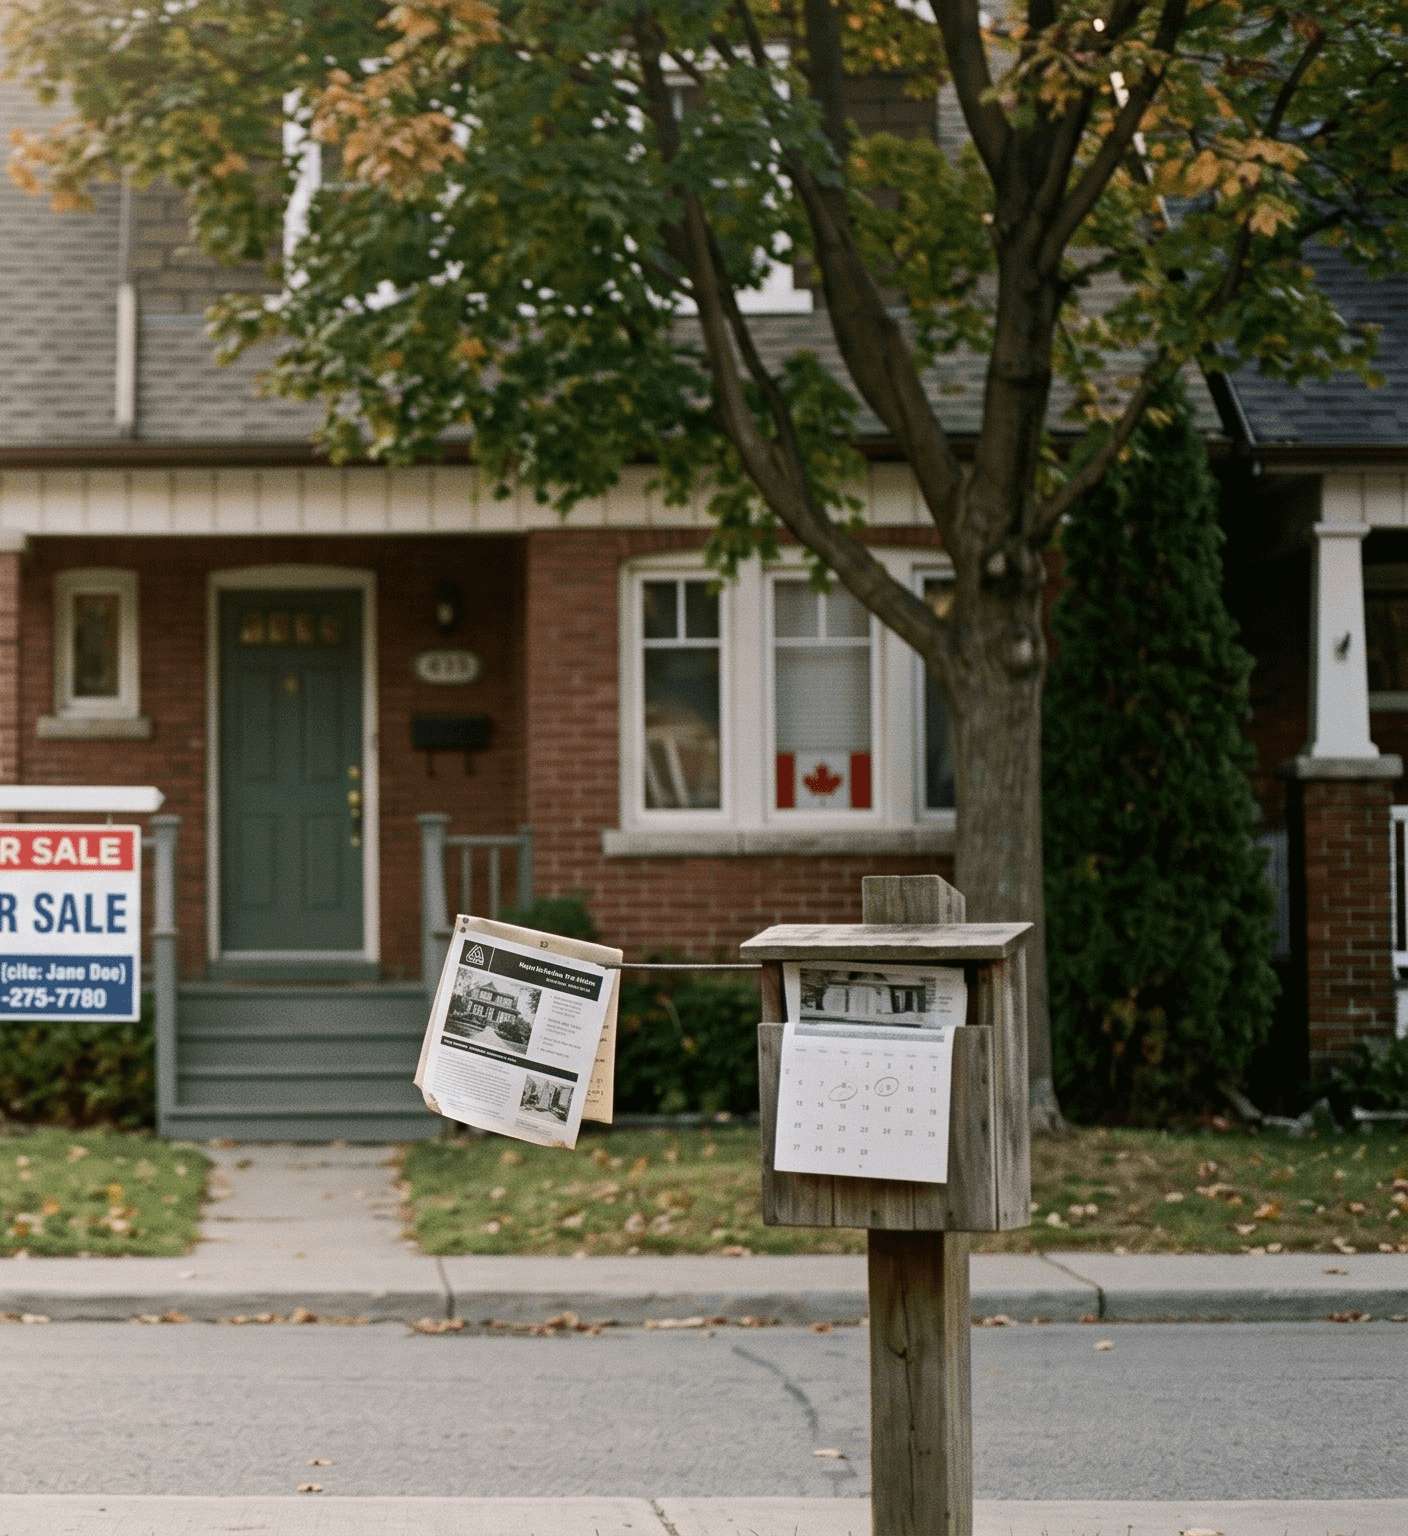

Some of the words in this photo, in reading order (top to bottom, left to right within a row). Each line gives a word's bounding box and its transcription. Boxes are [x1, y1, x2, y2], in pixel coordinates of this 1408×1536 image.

[32, 837, 121, 866] SALE
[33, 892, 127, 934] SALE
[1, 962, 42, 984] (cite:
[46, 963, 86, 981] Jane
[90, 962, 126, 985] Doe)
